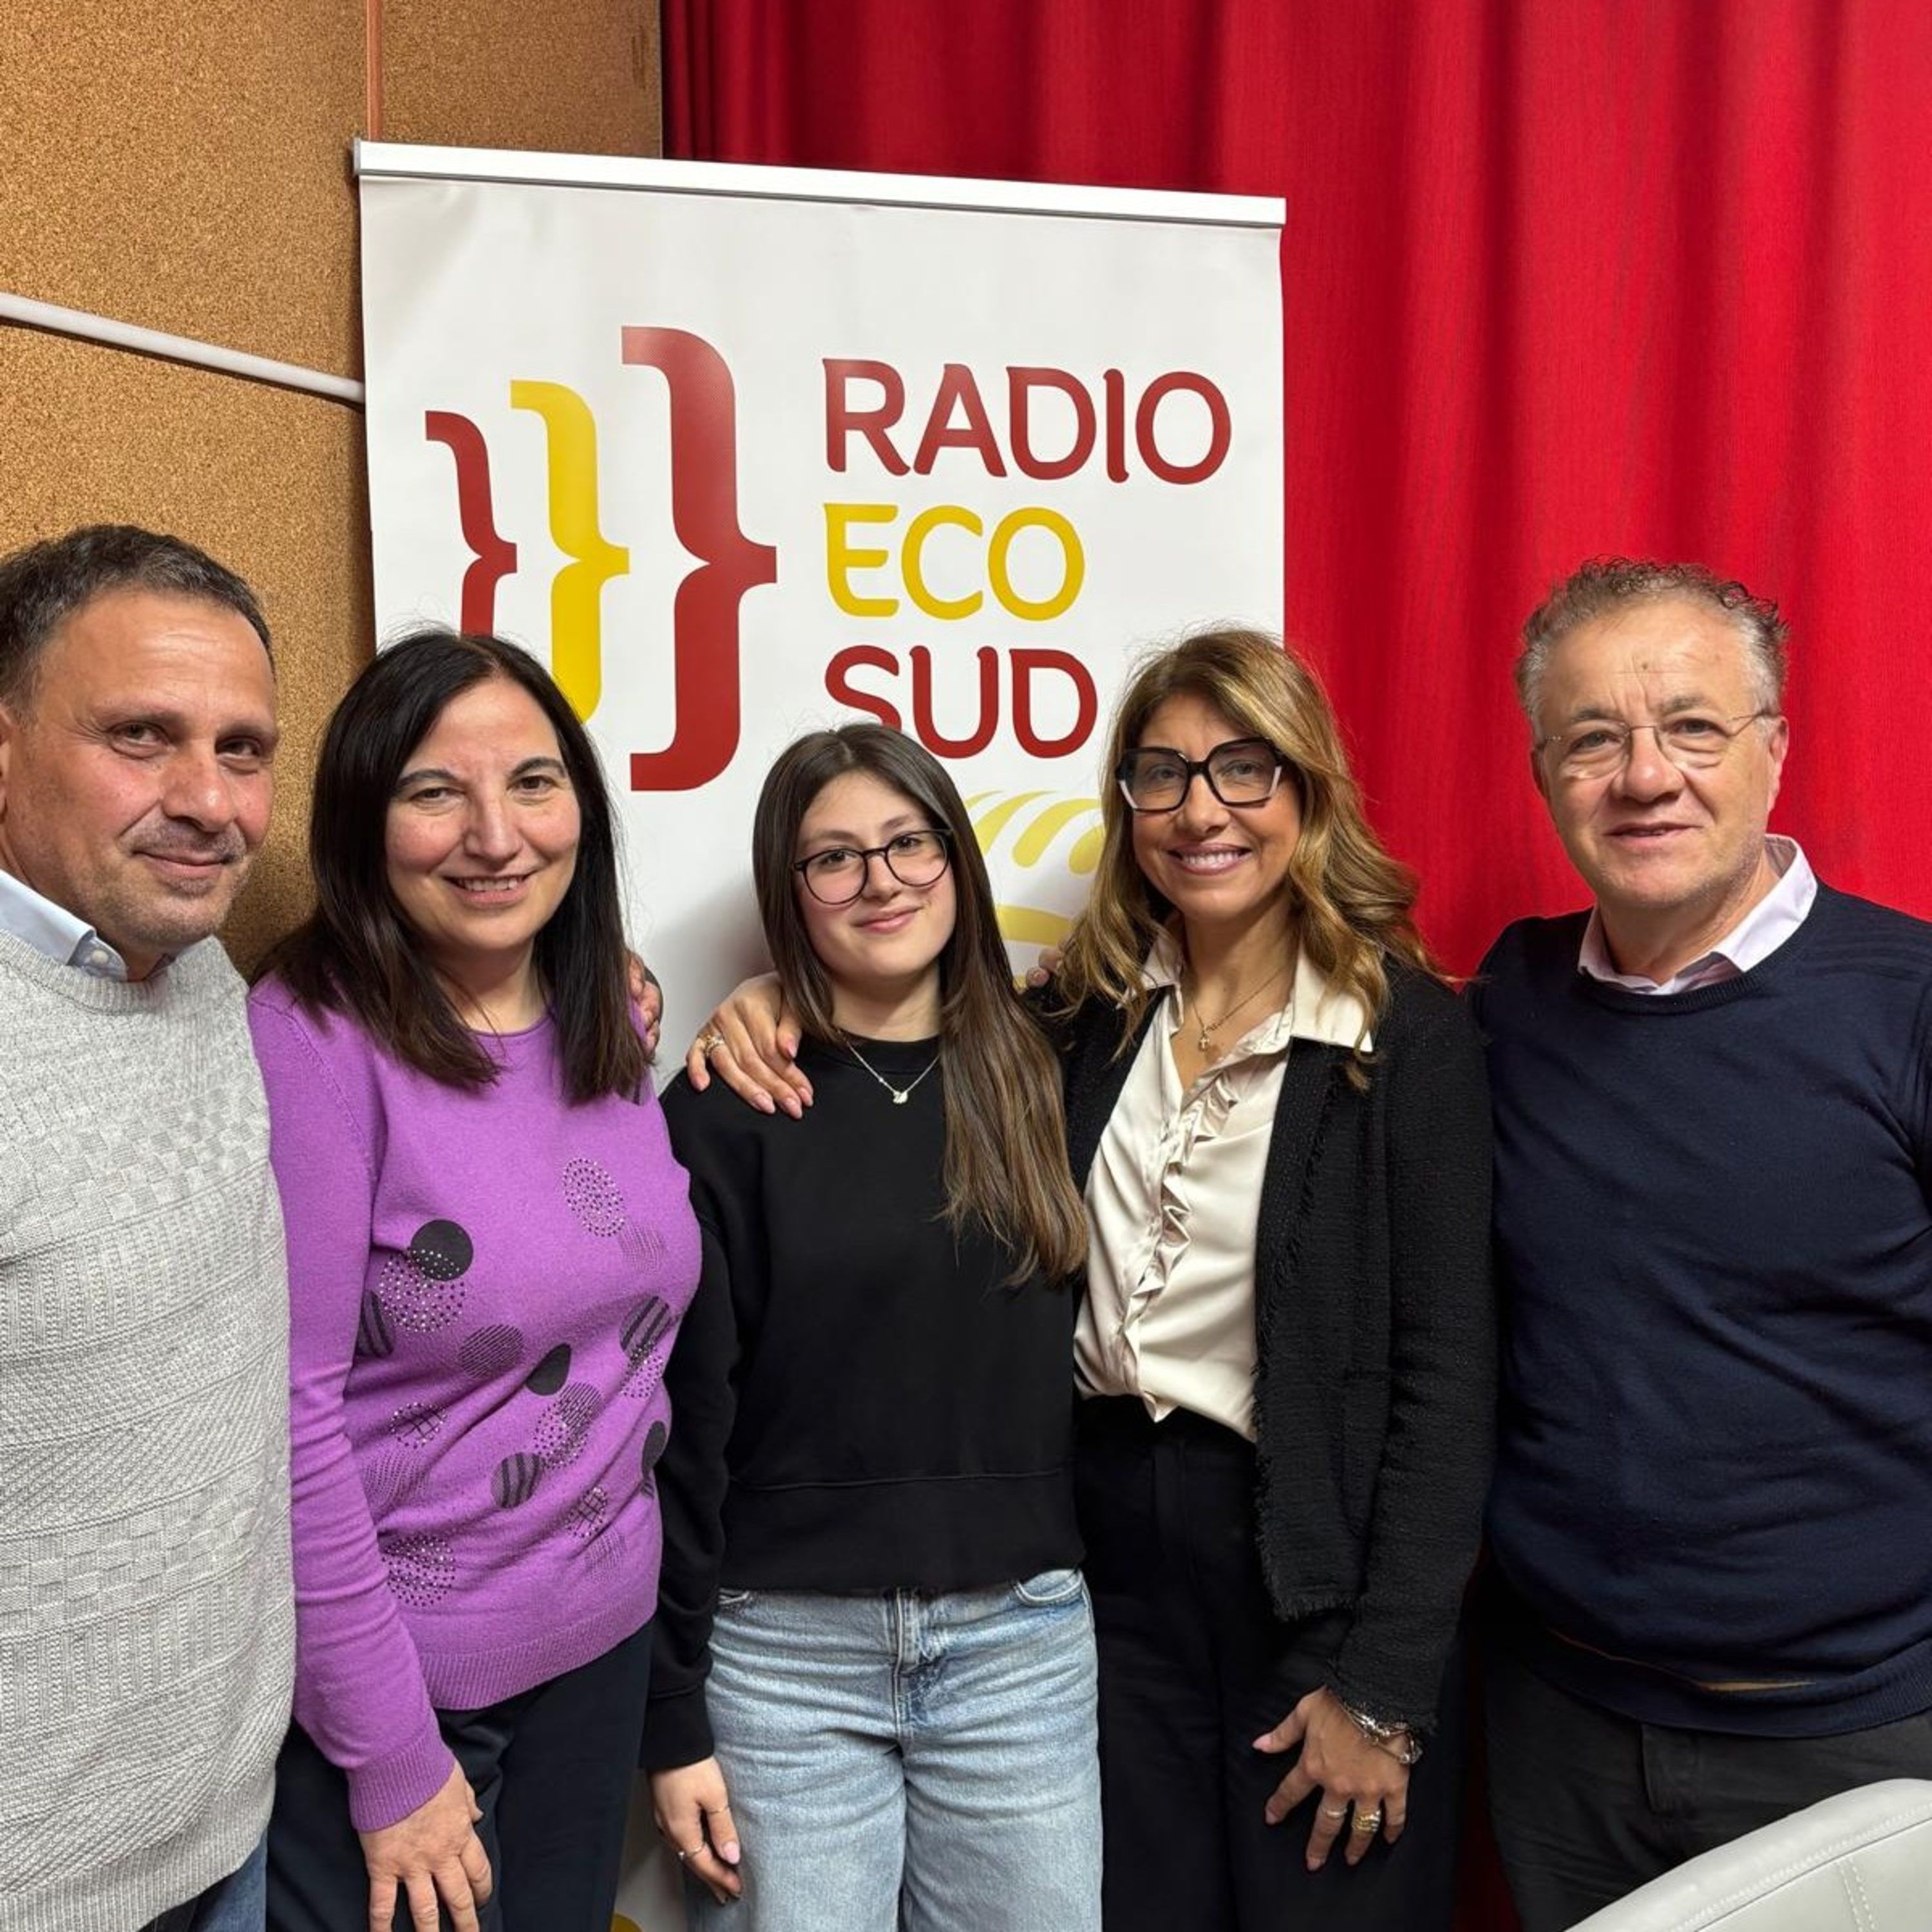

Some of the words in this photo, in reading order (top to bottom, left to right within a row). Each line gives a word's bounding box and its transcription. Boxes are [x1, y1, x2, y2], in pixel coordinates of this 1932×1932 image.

[822, 358, 1231, 484] RADIO
[823, 503, 1085, 621] ECO
[825, 645, 1097, 759] SUD
